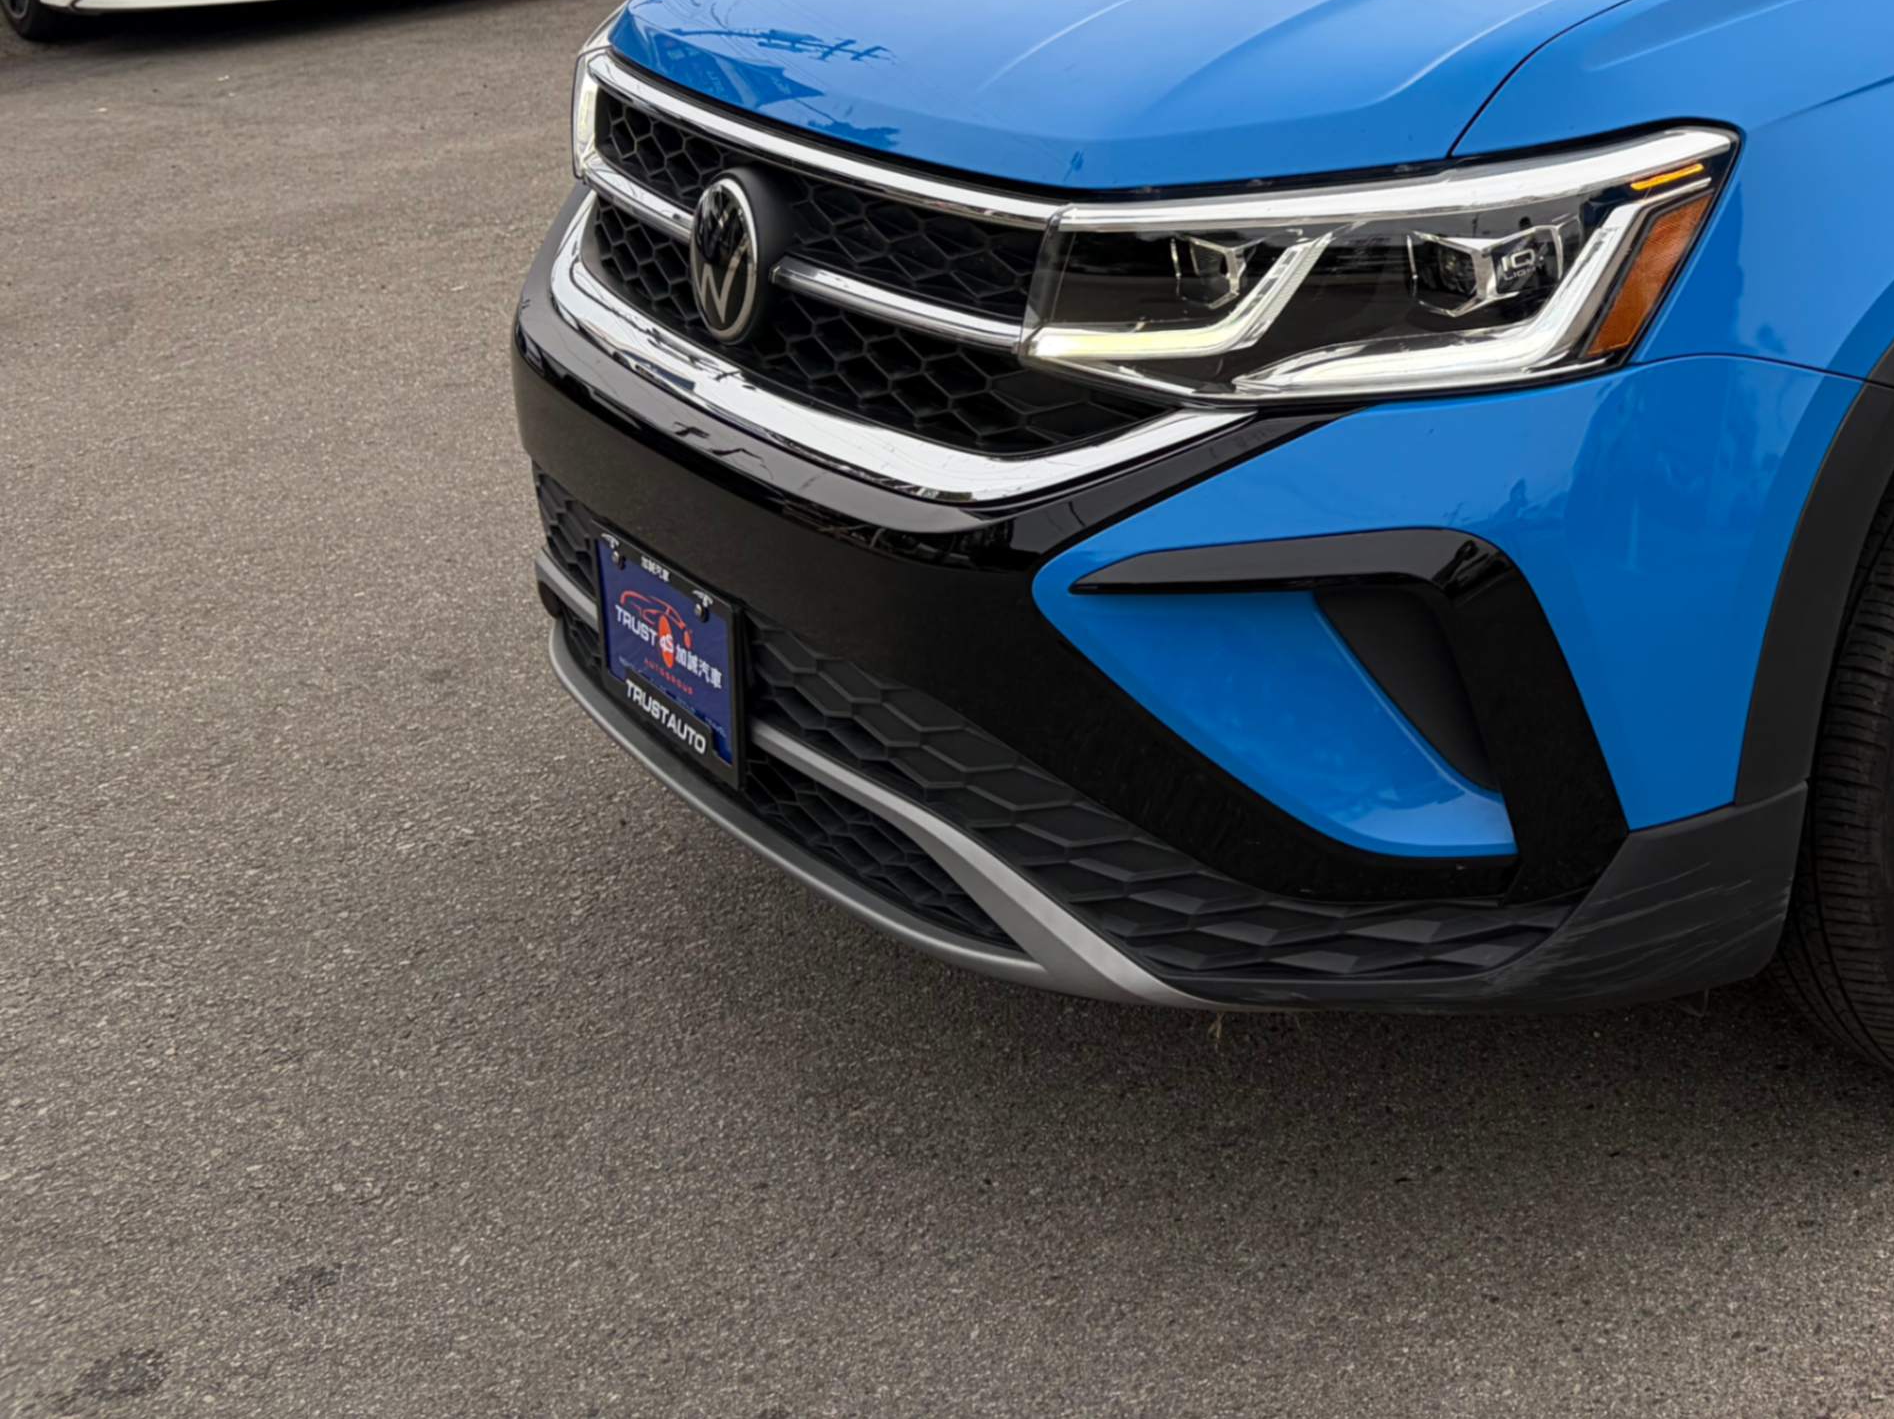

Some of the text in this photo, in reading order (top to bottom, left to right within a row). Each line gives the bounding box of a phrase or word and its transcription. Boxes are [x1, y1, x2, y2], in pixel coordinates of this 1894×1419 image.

[1502, 248, 1535, 272] IQ
[615, 605, 659, 646] TRUST
[626, 679, 706, 755] TRUSTAUTO
